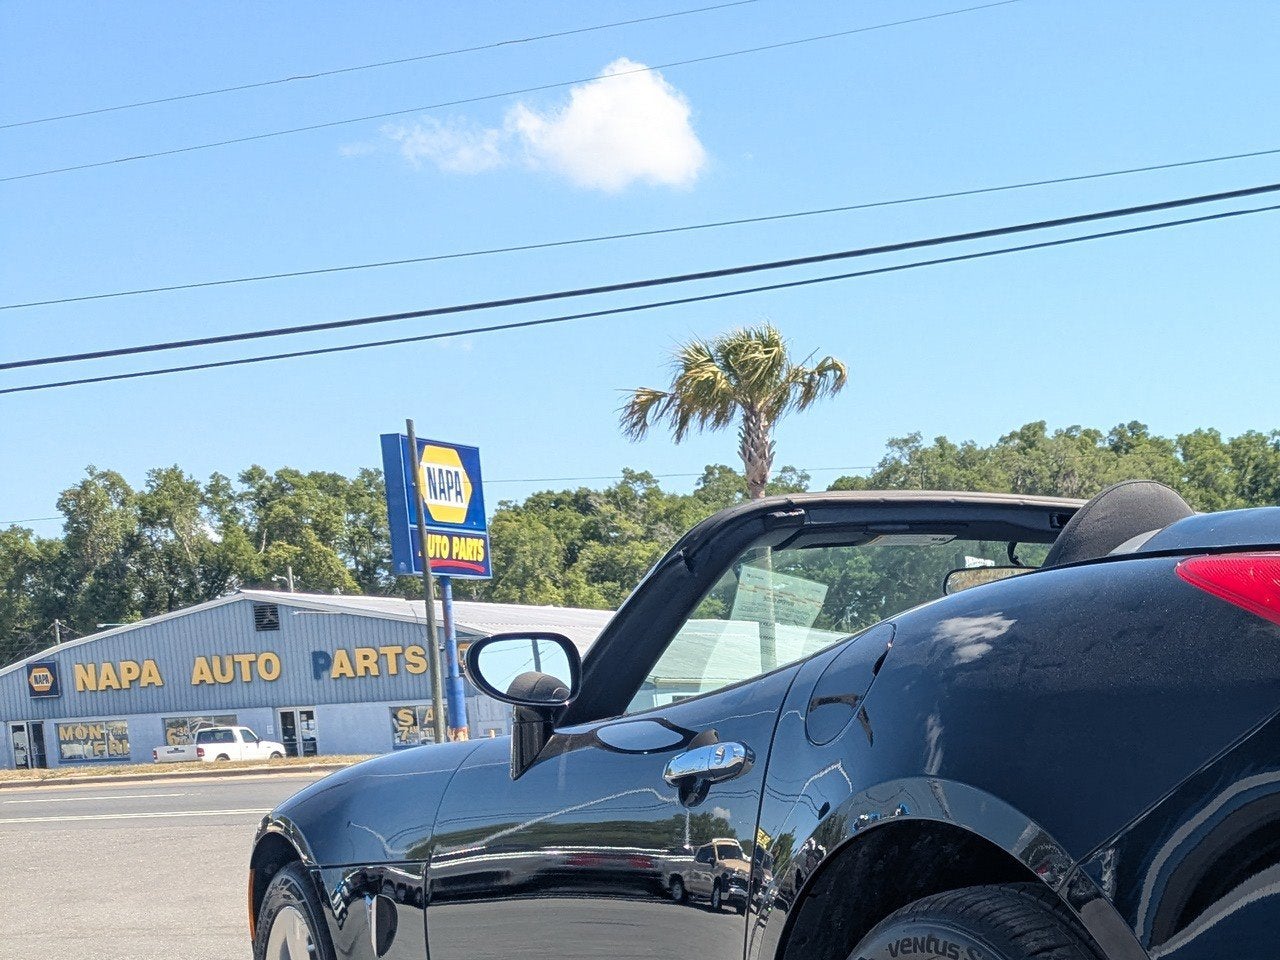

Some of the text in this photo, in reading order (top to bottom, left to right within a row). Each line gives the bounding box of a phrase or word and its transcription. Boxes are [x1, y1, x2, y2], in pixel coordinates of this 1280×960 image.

[426, 467, 464, 503] NAPA
[418, 534, 485, 562] UTO PARTS
[33, 674, 50, 685] NAPA
[74, 646, 428, 692] NAPA AUTO PARTS
[59, 724, 103, 740] MON
[93, 739, 130, 756] FRI
